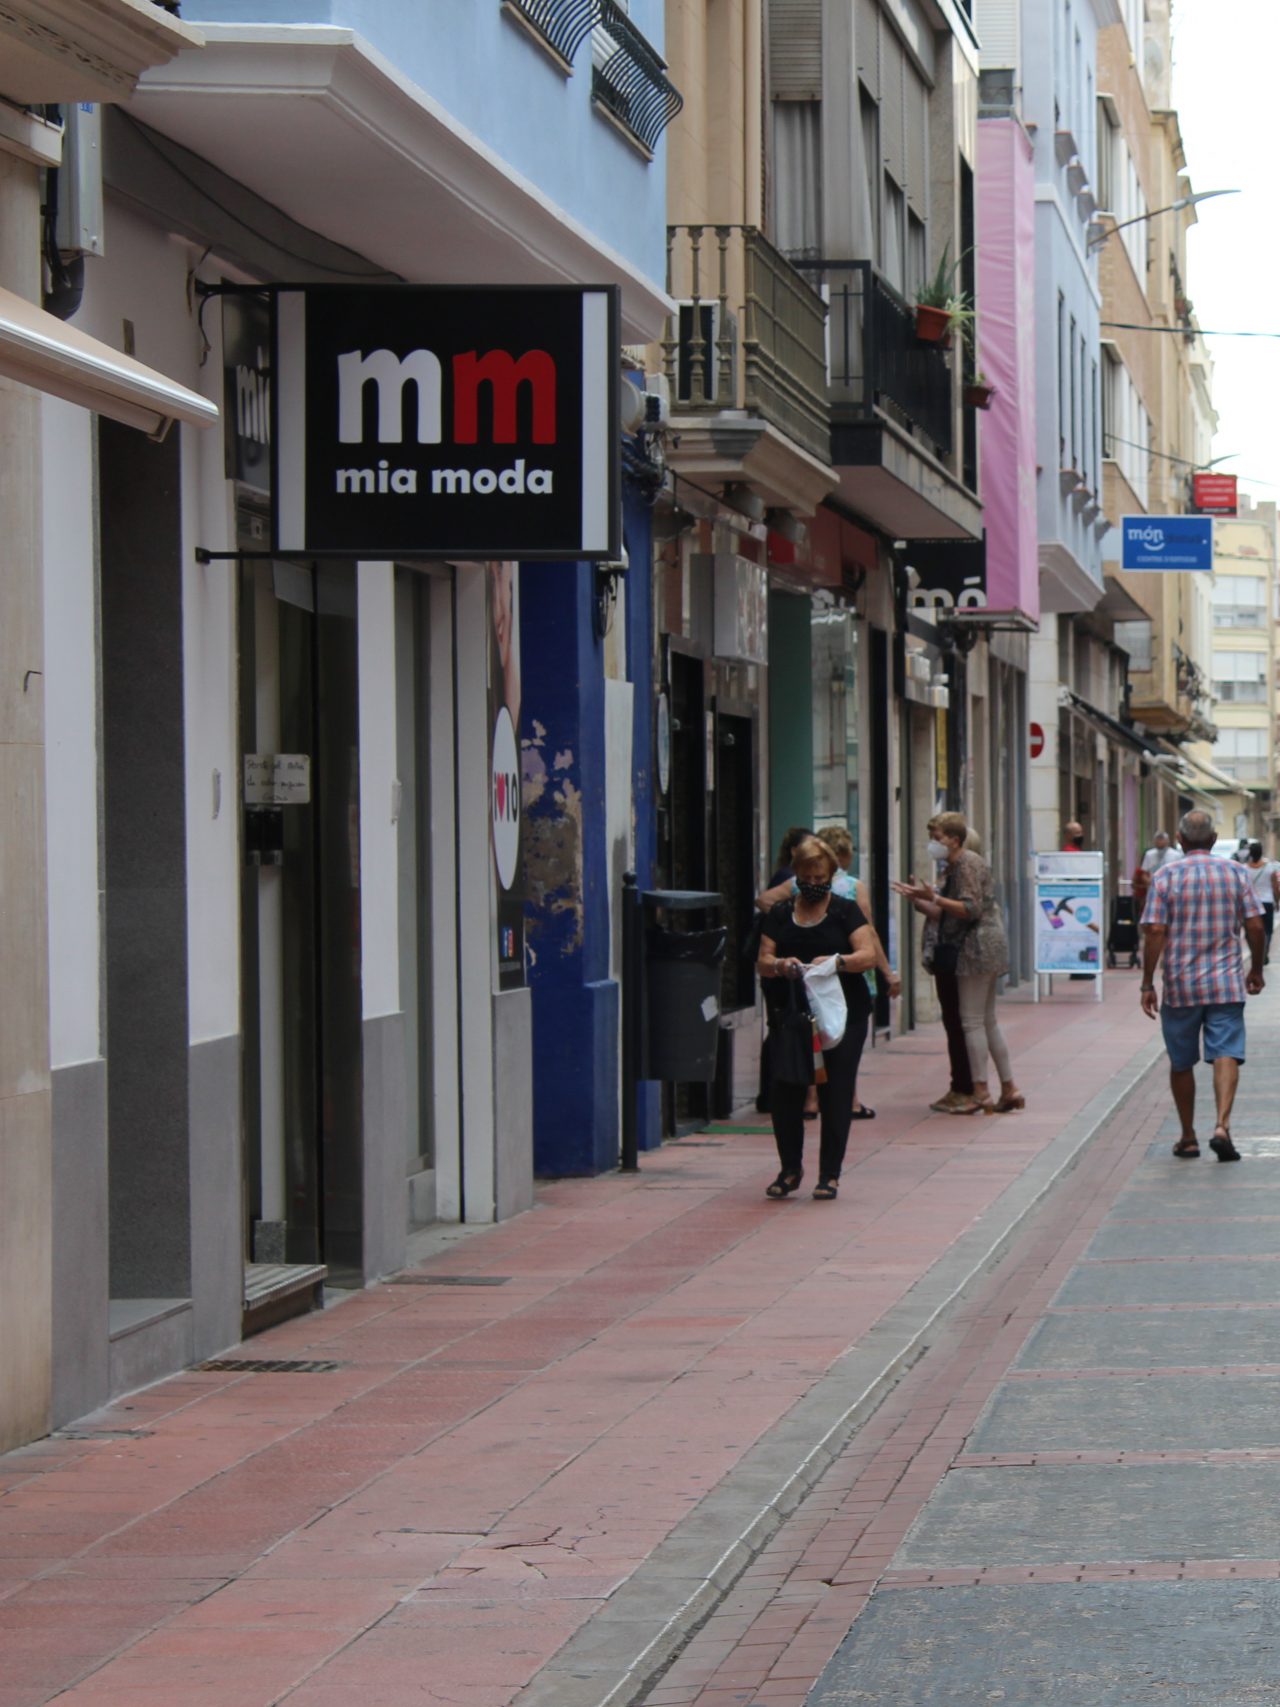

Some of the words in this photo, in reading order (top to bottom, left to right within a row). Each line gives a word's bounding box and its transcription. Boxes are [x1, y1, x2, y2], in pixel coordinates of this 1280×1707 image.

[337, 348, 557, 445] mm
[335, 459, 417, 494] mia
[431, 458, 553, 495] moda
